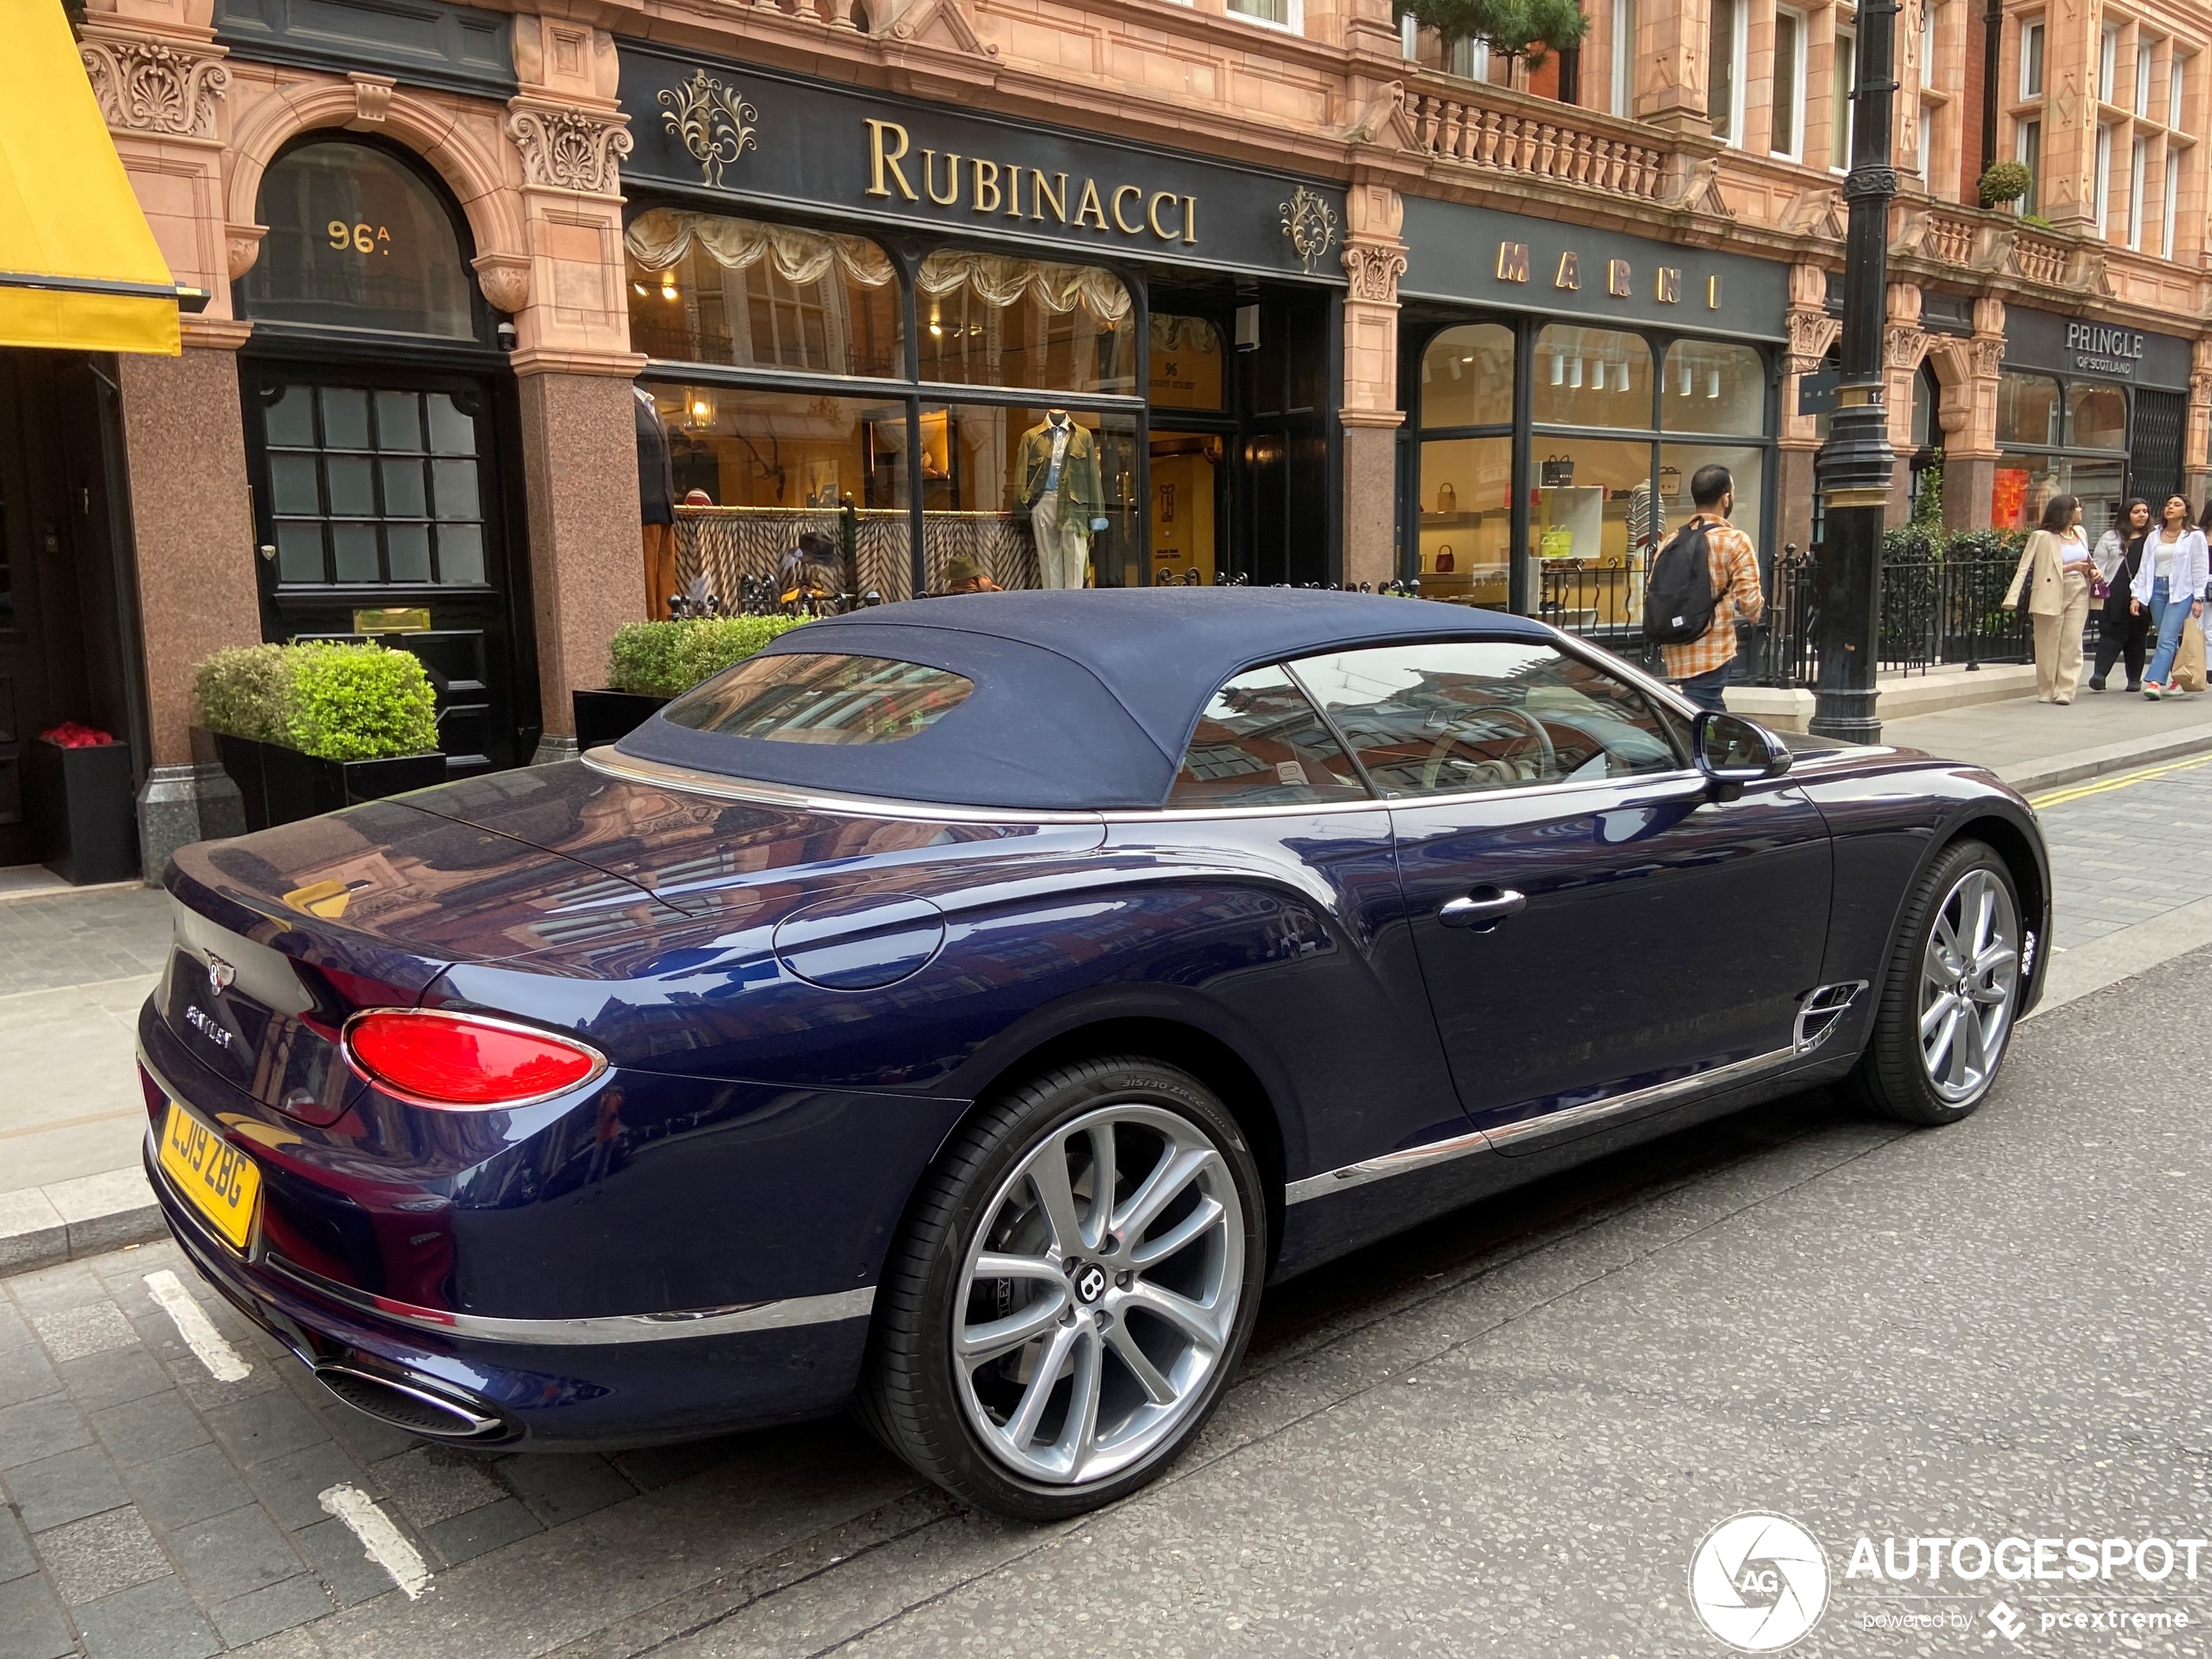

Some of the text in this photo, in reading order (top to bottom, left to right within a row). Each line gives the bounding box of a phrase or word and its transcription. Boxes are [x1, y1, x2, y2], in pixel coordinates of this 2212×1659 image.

[863, 118, 1198, 243] RUBINACCI
[1496, 241, 1723, 309] MARNI
[2065, 322, 2143, 359] PRINGLE
[2076, 356, 2131, 374] OF SCOTLAND
[1120, 1078, 1168, 1090] 315/30
[171, 1108, 246, 1208] LJ19 ZBG
[1081, 1268, 1105, 1301] B
